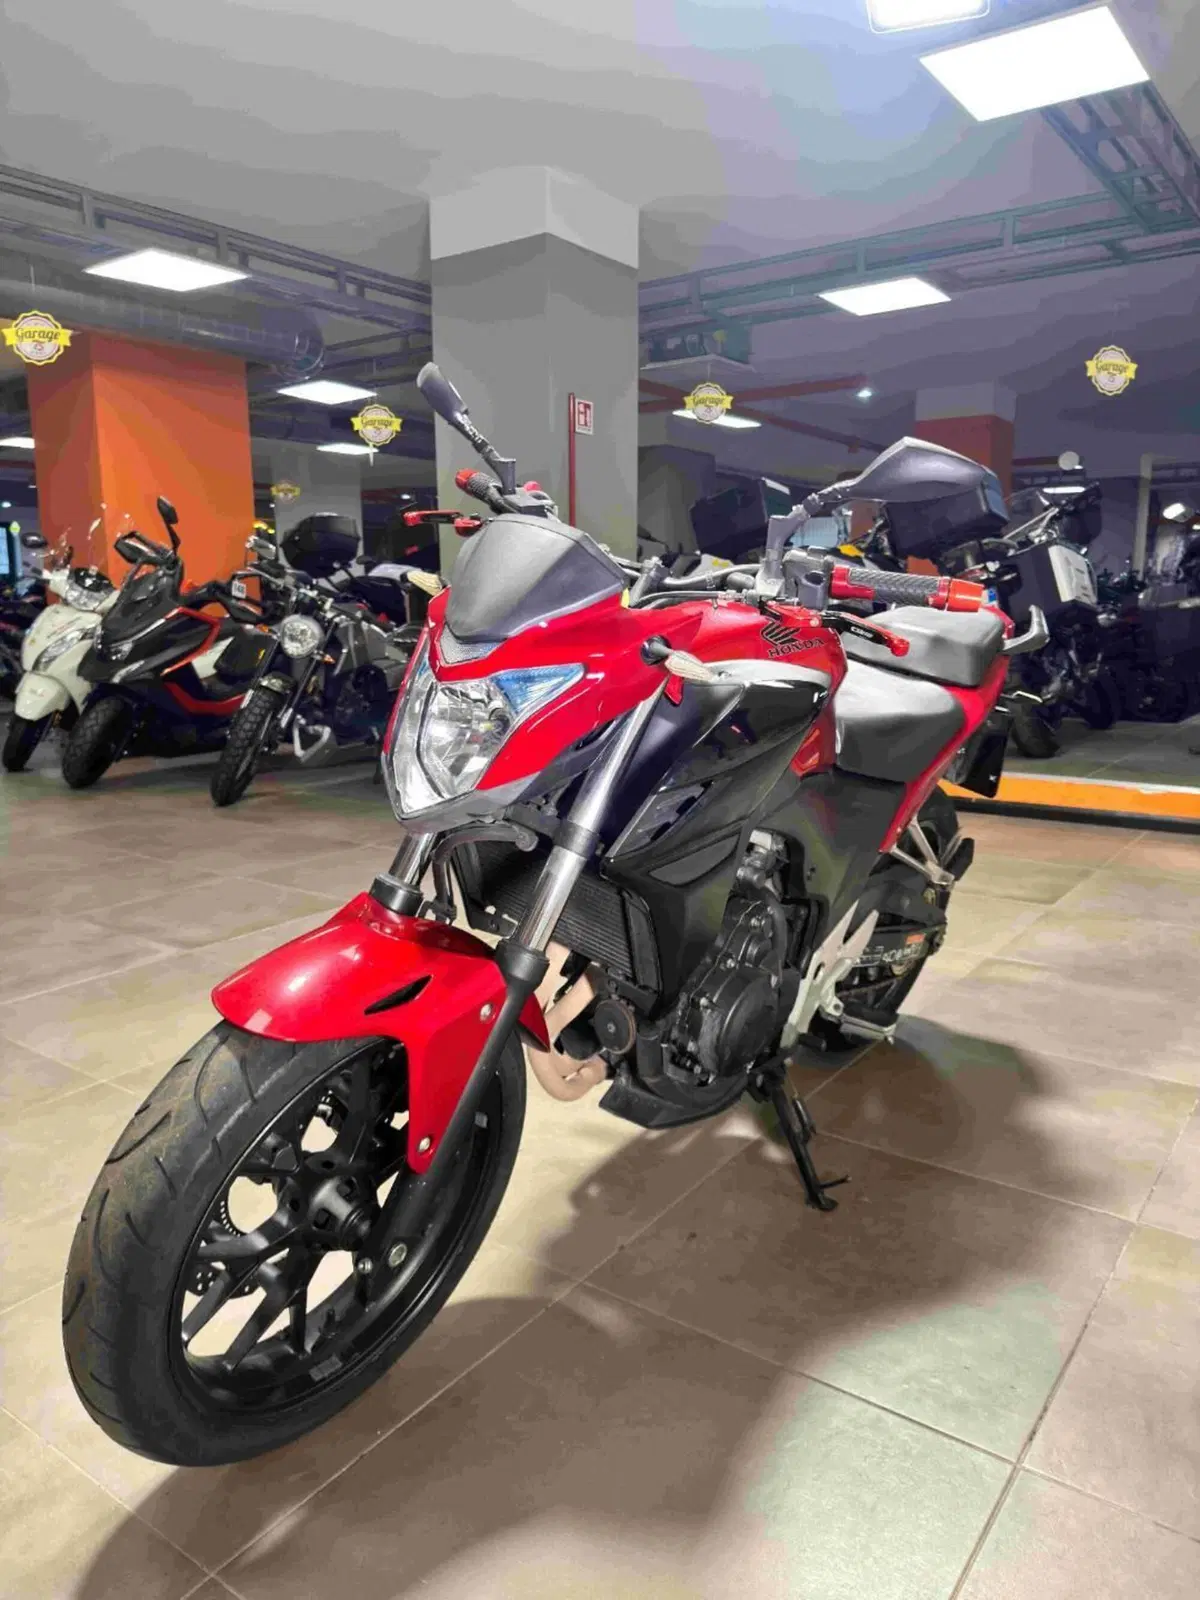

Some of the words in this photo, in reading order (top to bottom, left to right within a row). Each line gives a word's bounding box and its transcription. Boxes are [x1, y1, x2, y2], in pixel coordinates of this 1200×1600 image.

[16, 328, 60, 342] Garage
[693, 395, 723, 407] Garage
[361, 416, 392, 428] Garage
[768, 638, 825, 658] HONDA
